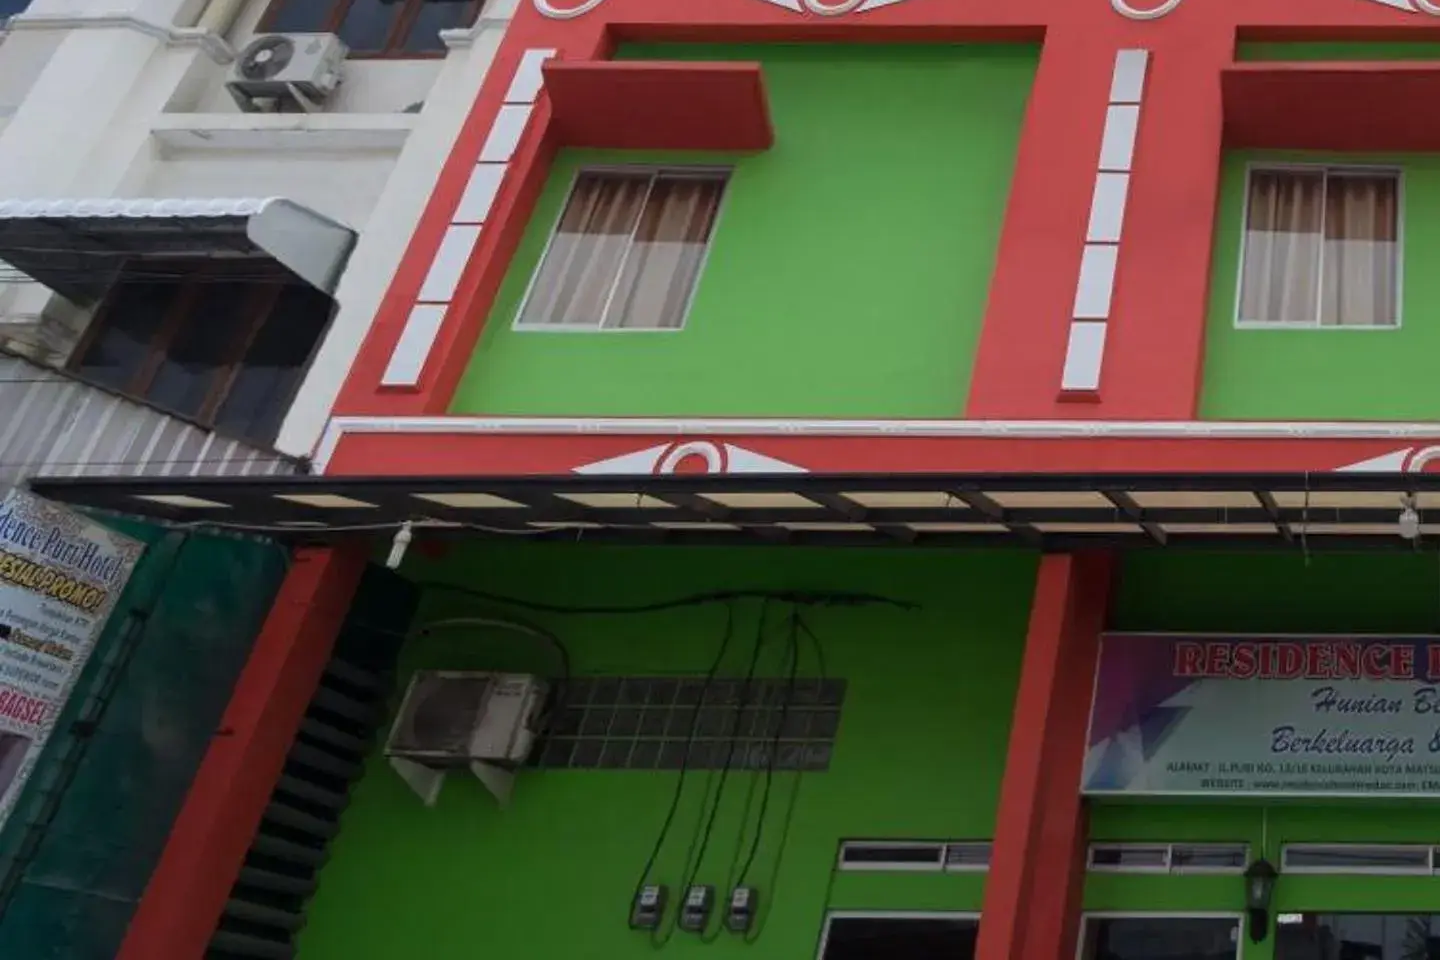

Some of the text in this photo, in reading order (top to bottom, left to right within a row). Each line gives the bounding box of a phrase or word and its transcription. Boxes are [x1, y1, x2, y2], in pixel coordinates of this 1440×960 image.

[1173, 642, 1415, 680] RESIDENCE
[1311, 686, 1403, 714] Hunian
[1271, 725, 1414, 761] Berkeluarga
